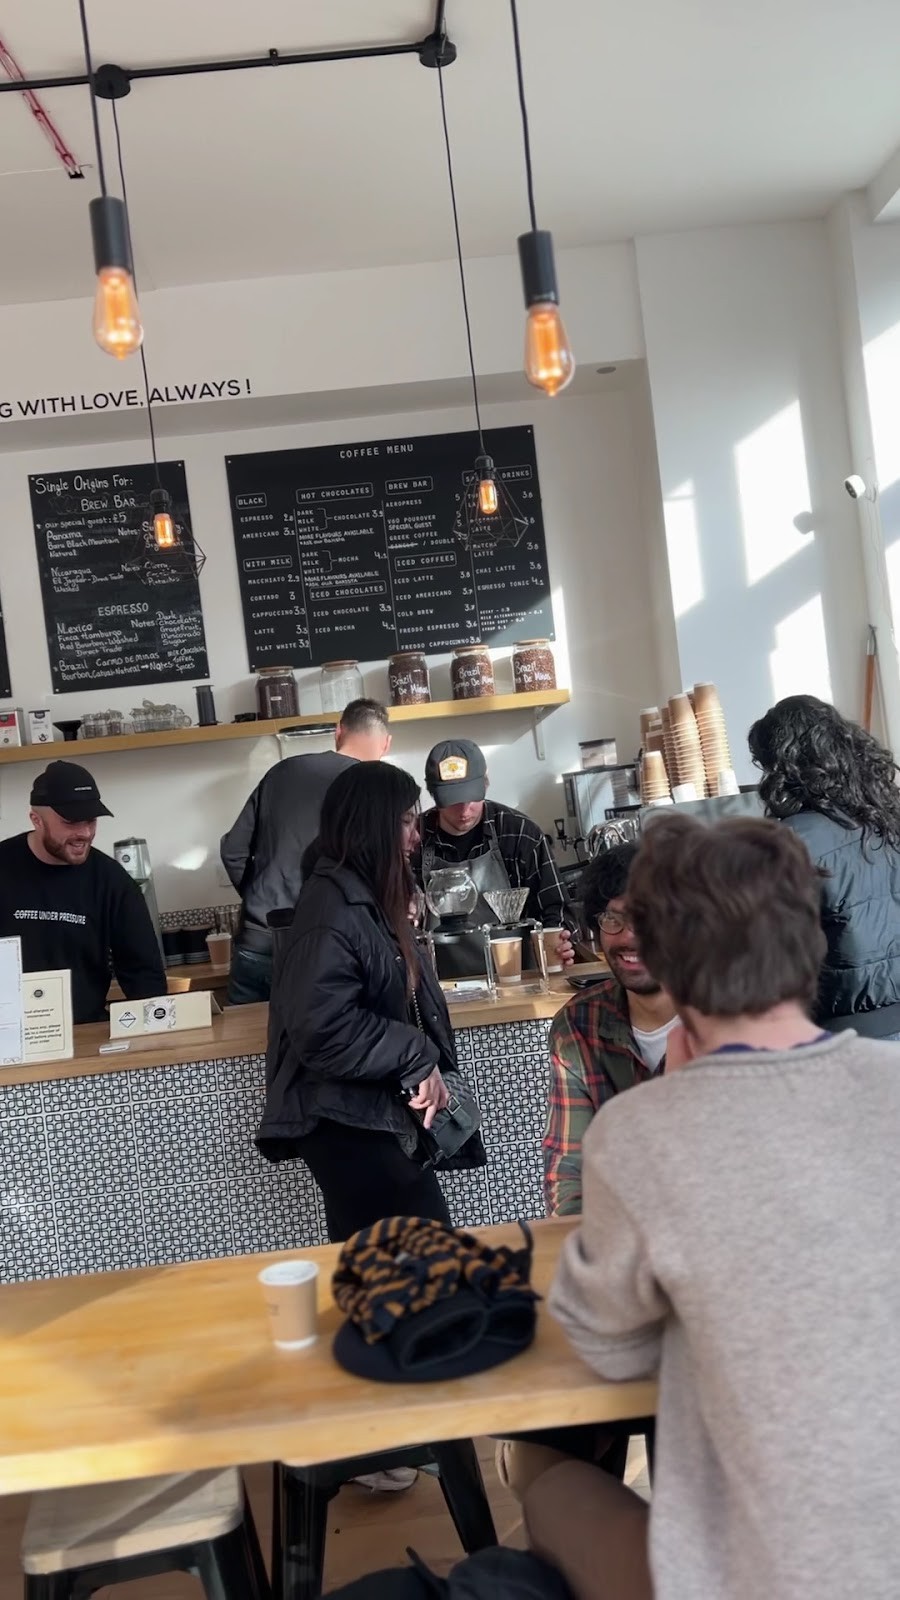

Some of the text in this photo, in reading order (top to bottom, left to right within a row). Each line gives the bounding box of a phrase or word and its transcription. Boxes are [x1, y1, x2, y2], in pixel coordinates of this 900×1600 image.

[18, 396, 76, 416] WITH
[81, 390, 144, 410] LOVE,
[340, 444, 413, 459] COFFEE MENU
[502, 470, 529, 478] DRINKS
[35, 474, 134, 496] Single Origins For:
[321, 487, 370, 498] CHOCOLATES
[238, 497, 264, 506] BLACK
[386, 499, 422, 508] AEROPRESS
[240, 514, 274, 523] ESPRESSO
[334, 512, 370, 521] CHOCOLATE
[404, 514, 436, 523] POUROVER
[60, 518, 85, 528] special
[46, 530, 83, 542] Panama
[242, 531, 279, 539] AMERICANO
[343, 528, 374, 536] AVAILABLE
[414, 531, 438, 539] COFFEE
[66, 540, 88, 548] Black
[88, 537, 120, 546] Mountain
[50, 549, 78, 558] Natural
[421, 555, 454, 564] COFFEES
[50, 566, 92, 578] Nicaragua
[248, 574, 300, 585] MACCHIATO 2.9
[53, 584, 80, 592] Washed
[335, 585, 384, 596] CHOCOLATES
[477, 583, 506, 591] ESPRESSO
[289, 591, 295, 600] 3
[416, 590, 452, 599] AMERICANO
[98, 602, 149, 616] ESPRESSO
[333, 606, 369, 616] CHOCOLATE
[156, 610, 177, 620] Dark
[252, 610, 293, 619] CAPPUCCINO
[56, 622, 93, 634] Mexico
[427, 622, 460, 631] ESPRESSO
[81, 630, 122, 640] Hamburgo
[60, 642, 74, 650] Red
[74, 640, 104, 650] Bourbon
[162, 638, 187, 646] Sugar
[75, 649, 100, 657] Direct
[58, 659, 88, 672] Brazil
[514, 660, 537, 675] Brazil
[457, 666, 480, 679] Brazil
[390, 672, 413, 688] Brazil
[14, 910, 86, 925] COFFEE UNDER PRESSURE
